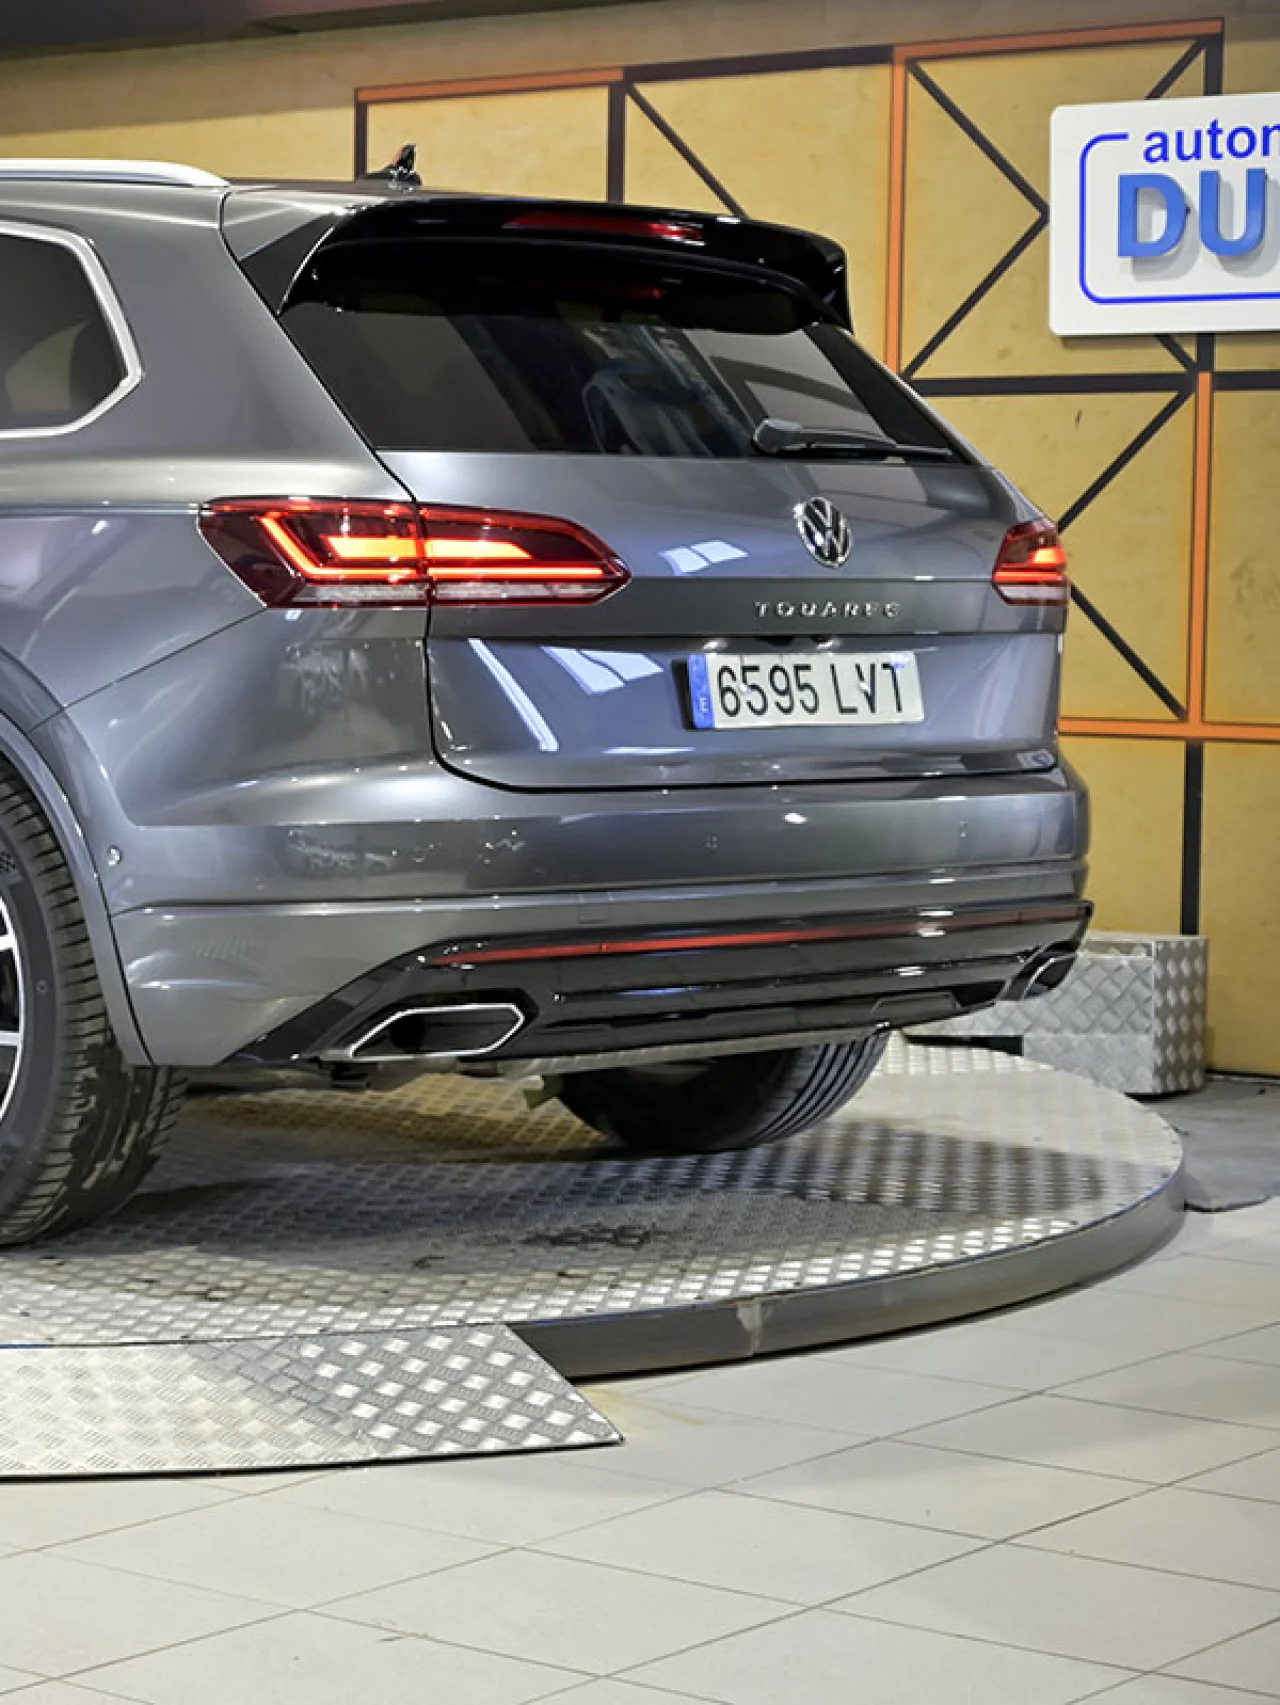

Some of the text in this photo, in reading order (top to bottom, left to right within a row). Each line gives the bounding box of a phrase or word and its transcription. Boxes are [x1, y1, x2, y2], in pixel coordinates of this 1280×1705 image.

[754, 600, 902, 619] TOUAREG
[716, 663, 819, 718] 6595
[829, 662, 905, 716] LVT
